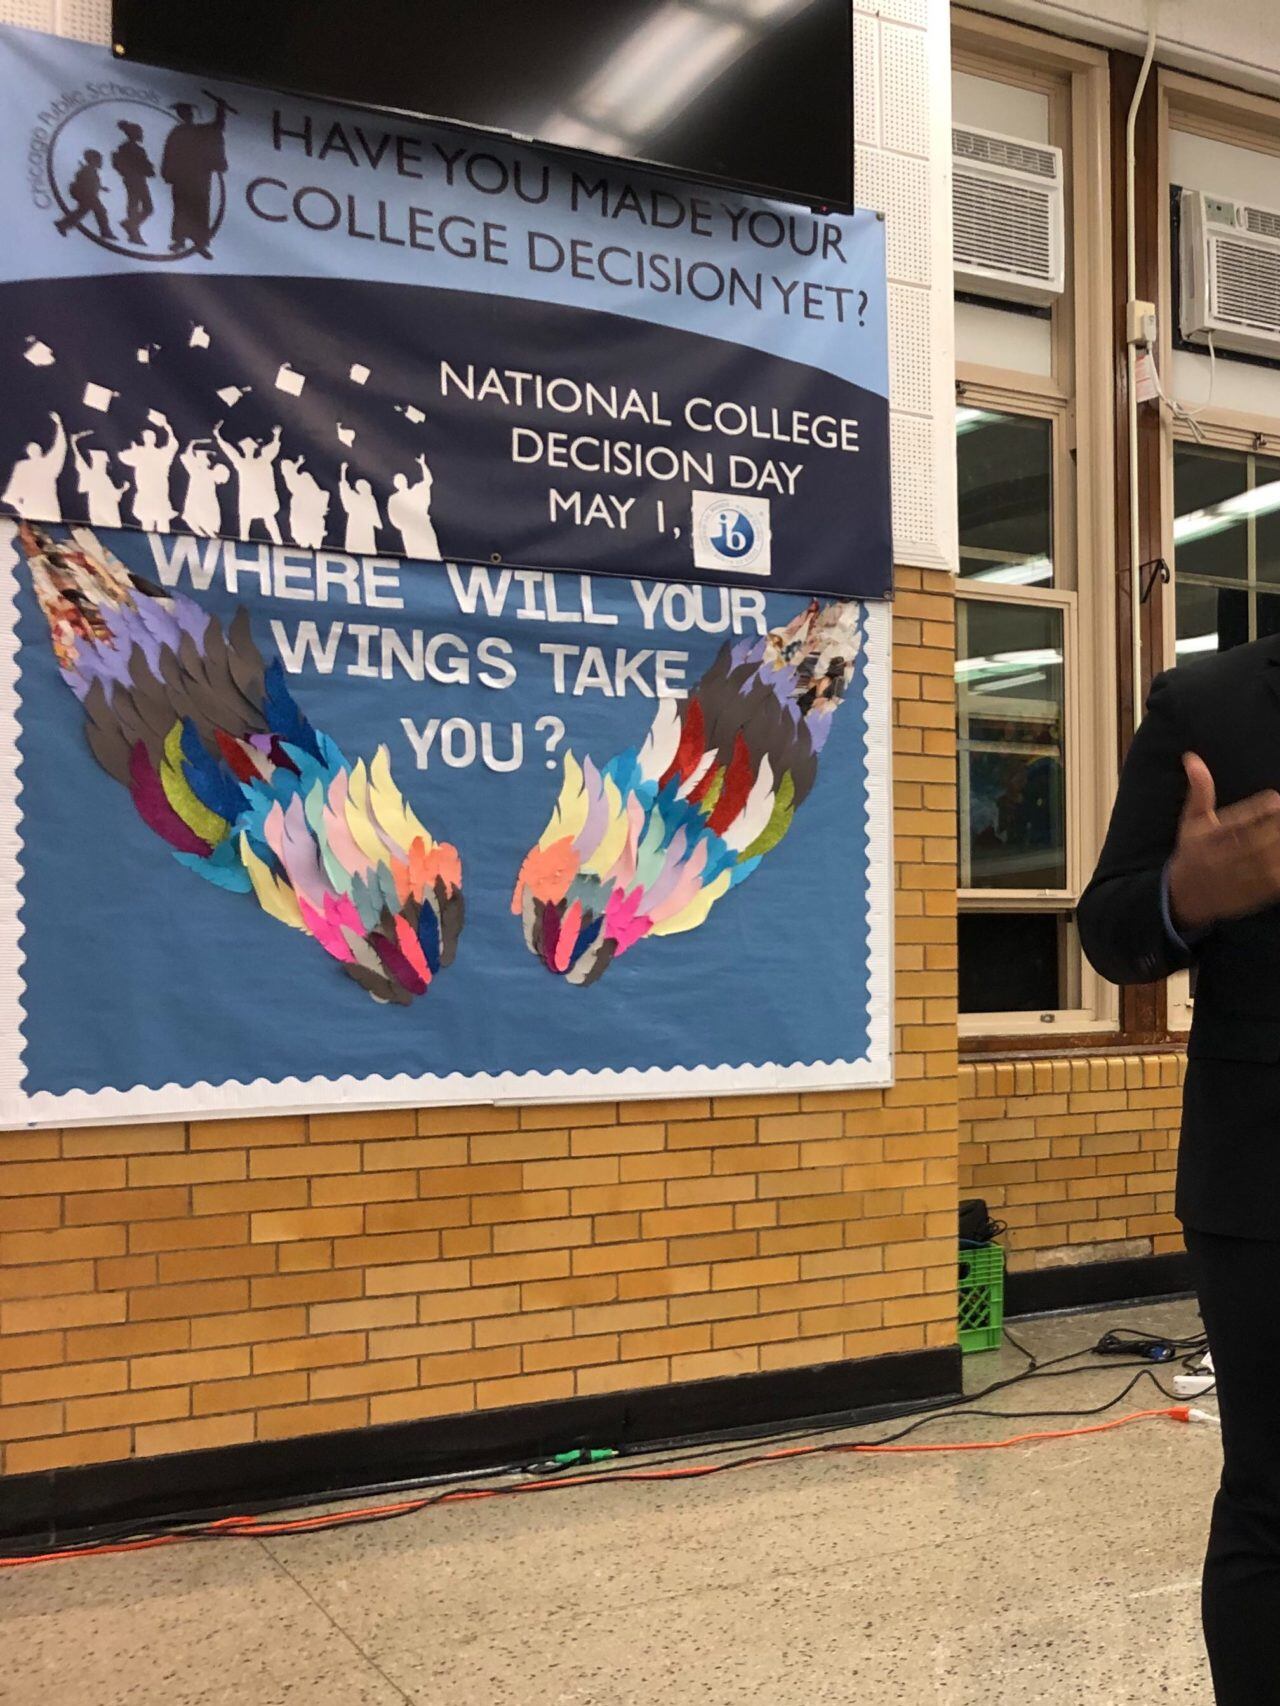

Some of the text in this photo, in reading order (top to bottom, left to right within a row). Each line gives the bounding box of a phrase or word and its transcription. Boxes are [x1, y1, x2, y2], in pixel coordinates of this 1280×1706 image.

[272, 109, 847, 264] HAVE YOU MADE YOUR
[245, 176, 869, 328] COLLEGE DECISION YET?
[440, 360, 861, 452] NATIONAL COLLEGE
[511, 427, 804, 496] DECISION DAY
[548, 488, 636, 530] MAY
[656, 500, 682, 540] 1,
[147, 531, 768, 637] WHERE WILL YOUR
[269, 619, 690, 700] WINGS TAKE
